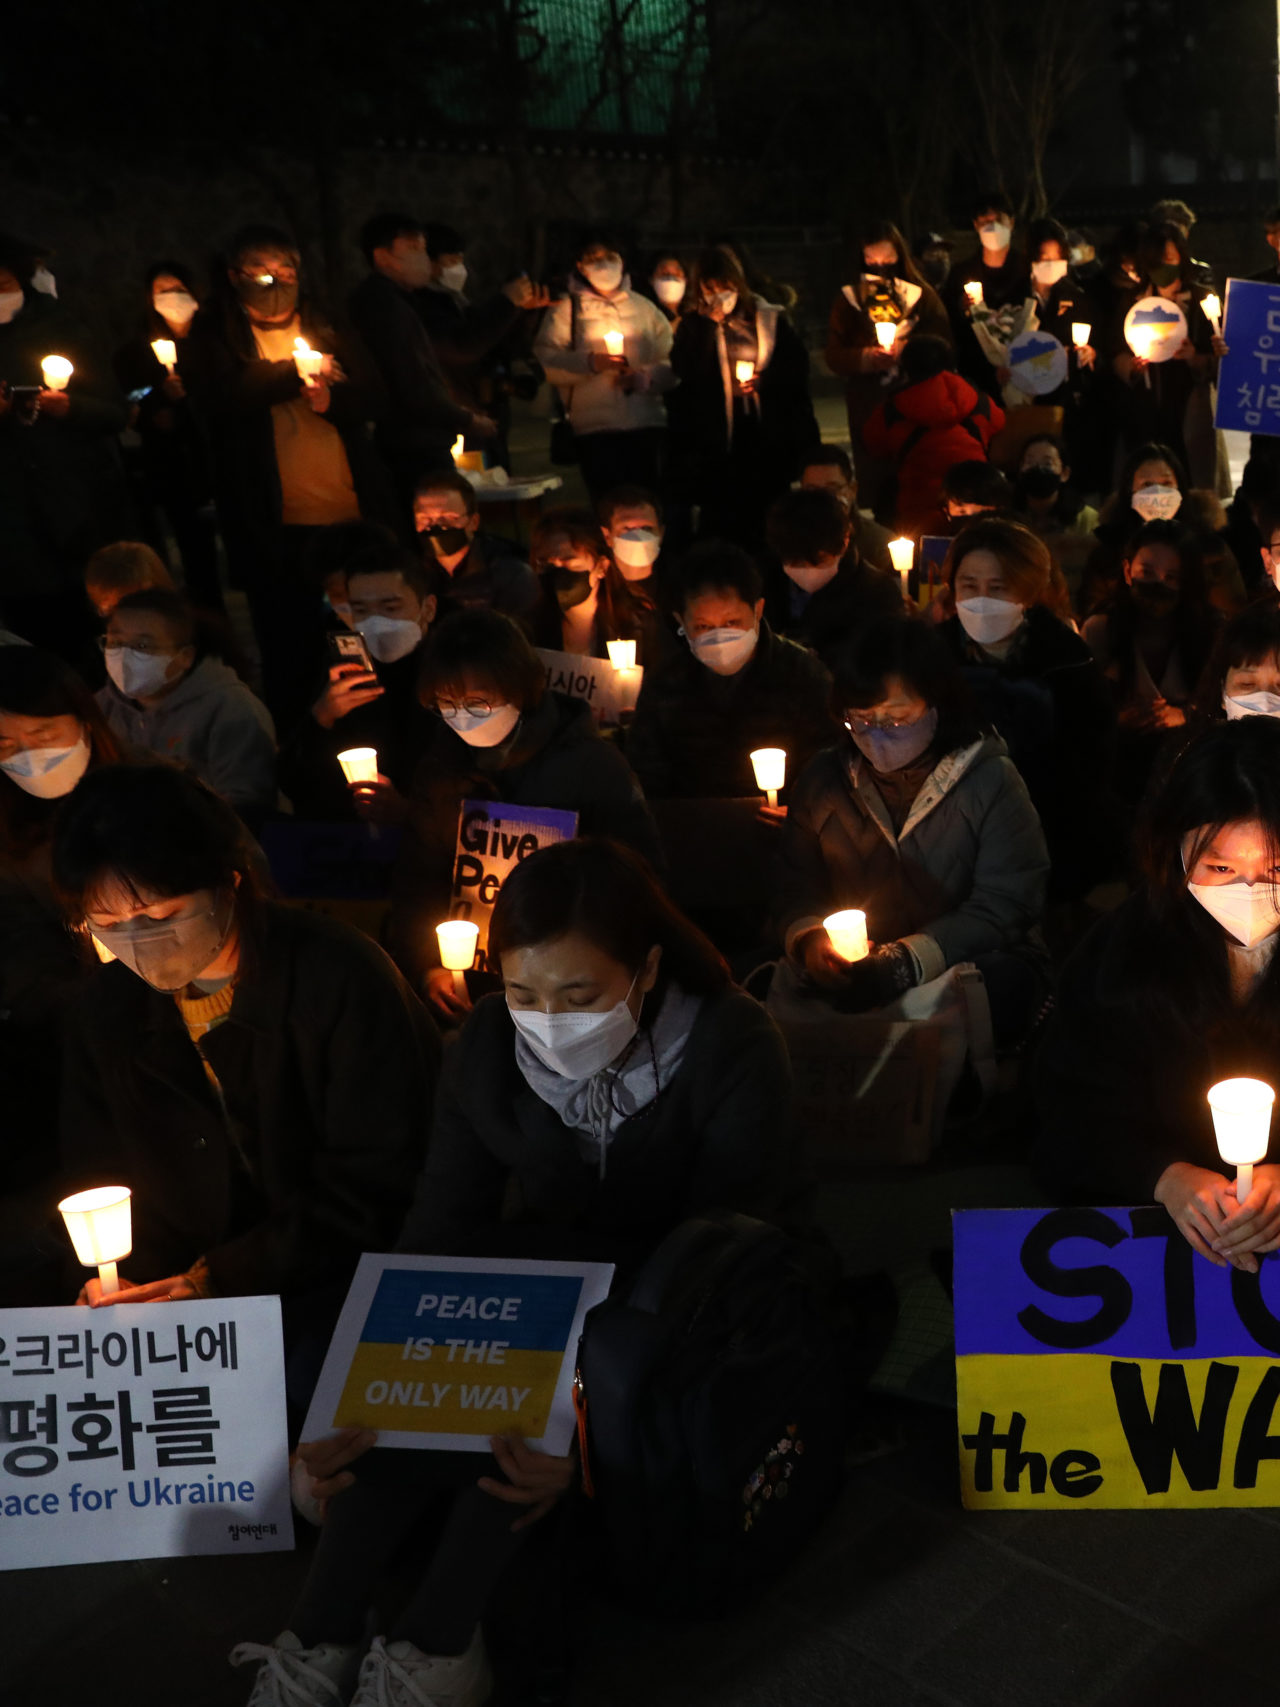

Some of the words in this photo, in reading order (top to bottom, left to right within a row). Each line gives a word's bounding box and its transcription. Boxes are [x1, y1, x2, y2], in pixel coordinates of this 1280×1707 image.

[460, 810, 538, 862] Give
[415, 1293, 522, 1322] PEACE
[401, 1336, 434, 1361] IS
[444, 1338, 510, 1365] THE
[365, 1380, 450, 1409] ONLY
[459, 1384, 532, 1412] WAY
[0, 1386, 220, 1477] 평화를
[961, 1411, 1104, 1498] the
[0, 1493, 59, 1517] ace
[71, 1483, 118, 1512] for
[128, 1474, 255, 1507] Ukraine
